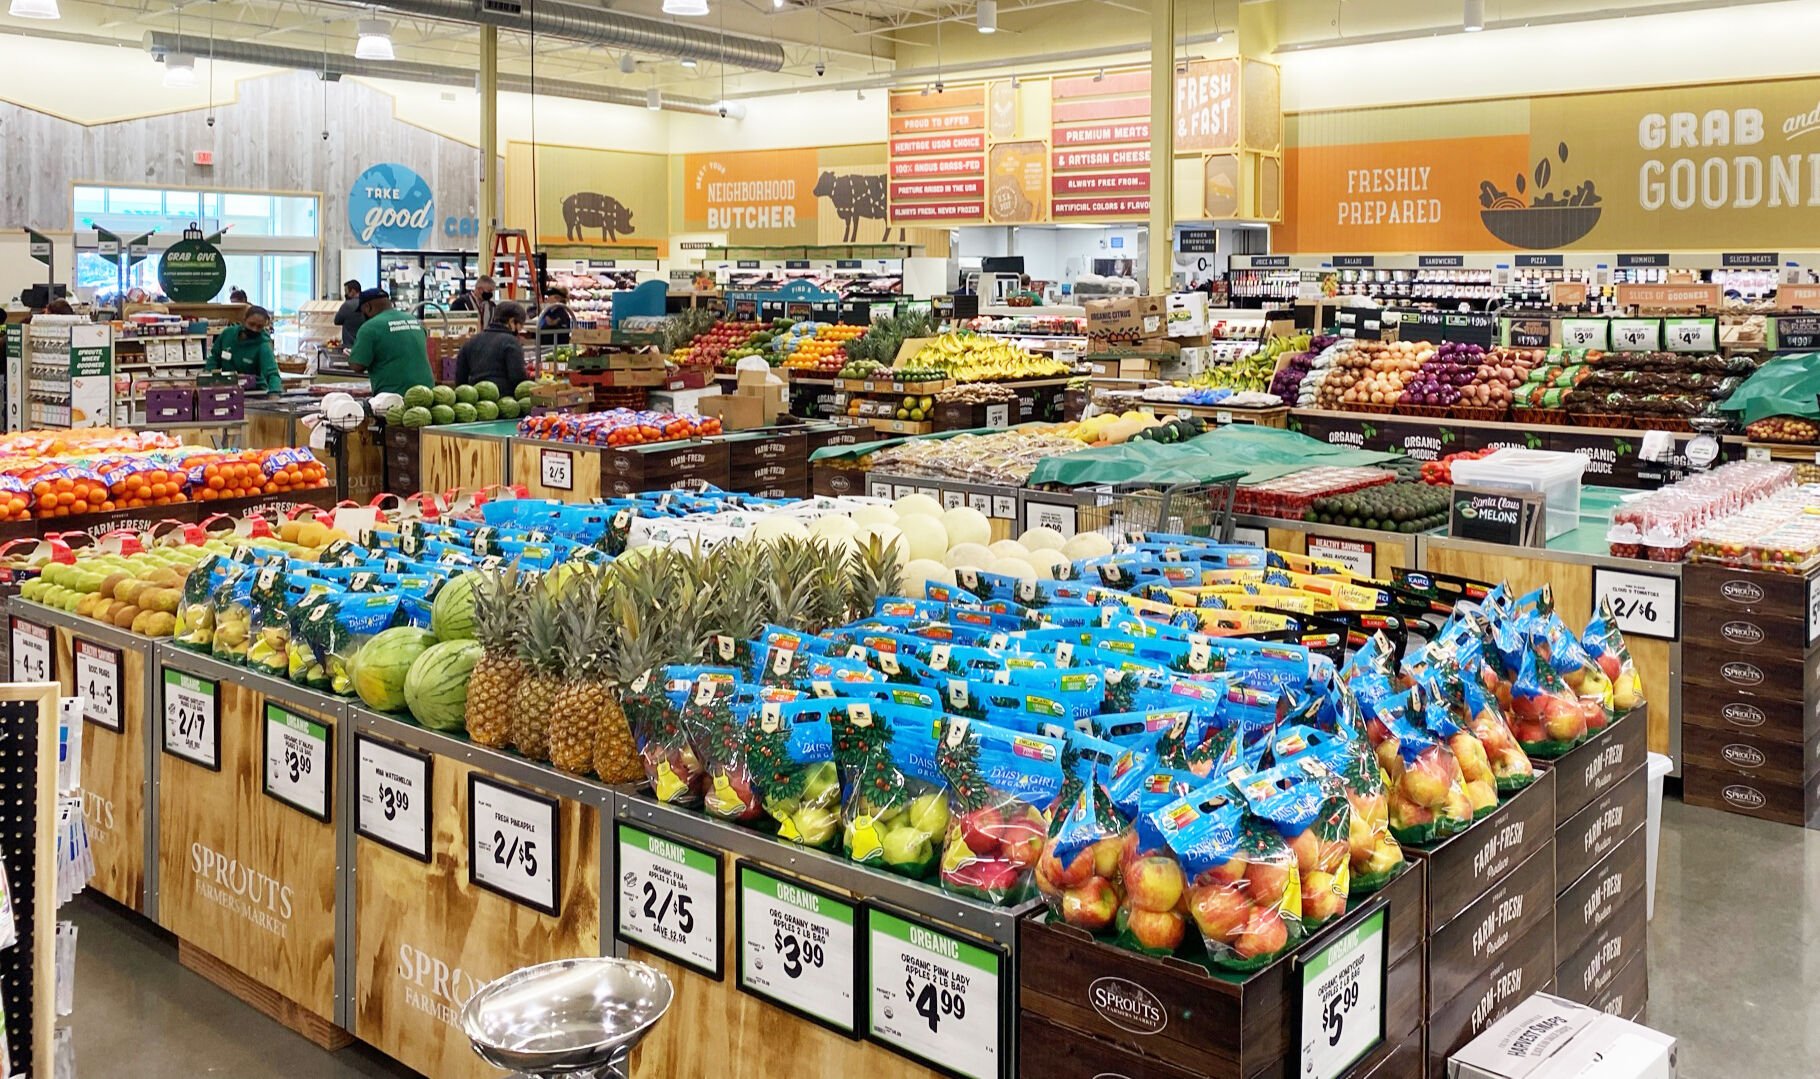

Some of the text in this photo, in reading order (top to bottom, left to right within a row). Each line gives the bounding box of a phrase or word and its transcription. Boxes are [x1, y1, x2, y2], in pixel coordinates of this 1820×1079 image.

[1176, 73, 1232, 114] FRESH
[904, 116, 969, 128] PROUD TO OFFER
[1177, 98, 1232, 136] & FAST
[1066, 126, 1148, 142] PREMIUM MEATS
[1638, 107, 1765, 151] GRAB
[895, 141, 929, 152] HERITAGE
[953, 138, 980, 148] CHOICE
[896, 160, 980, 173] 100% ANGUS GRASS-FED
[1058, 155, 1065, 166] &
[1068, 152, 1110, 165] ARTISAN
[965, 184, 977, 192] USA
[1068, 177, 1146, 188] ALWAYS FREE FROM...
[1347, 166, 1433, 194] FRESHLY
[365, 188, 400, 199] TAKE
[708, 180, 795, 202] NEIGHBORHOOD
[708, 205, 796, 229] BUTCHER
[895, 208, 916, 216] ALWAYS
[938, 206, 956, 214] NEVER
[957, 205, 979, 213] FROZEN
[1055, 203, 1090, 212] ARTIFICIAL
[1092, 202, 1118, 210] COLORS
[1337, 199, 1441, 225] PREPARED
[362, 200, 432, 241] good
[167, 252, 217, 262] GRAB GIVE
[1729, 255, 1750, 263] SLICED
[1629, 291, 1654, 300] SLICES
[1091, 310, 1131, 320] ORGANIC CITRUS
[1328, 431, 1364, 445] ORGANIC
[1404, 436, 1442, 451] ORGANIC
[754, 443, 785, 455] FARM-FRESH
[1407, 448, 1438, 461] PRODUCE
[670, 453, 705, 467] FARM-FRESH
[754, 467, 785, 479] FARM-FRESH
[1471, 496, 1520, 510] Santa Claus
[1478, 508, 1518, 525] MELONS
[87, 519, 151, 537] FARM-FRESH
[1315, 539, 1365, 552] HEALTHY SAVINGS
[1724, 586, 1760, 597] SPROUTS
[1614, 597, 1657, 622] 2/$6
[1724, 627, 1761, 638] SPROUTS
[1724, 667, 1760, 679] SPROUTS
[1725, 709, 1761, 721] SPROUTS
[909, 752, 938, 771] DAISY
[1585, 744, 1624, 787] FARM-FRESH
[1725, 750, 1761, 762] SPROUTS
[385, 771, 412, 787] WATERMELON
[990, 768, 1058, 789] DAISY GIRL
[1726, 790, 1761, 803] SPROUTS
[1584, 806, 1623, 853] FARM-FRESH
[494, 830, 537, 877] 2/$5
[648, 836, 685, 864] ORGANIC
[1473, 821, 1524, 878] FARM-FRESH
[648, 871, 665, 883] APPLES
[652, 863, 683, 881] ORGANIC FUJI
[1486, 856, 1509, 881] Produce
[191, 842, 292, 919] SPROUTS
[195, 878, 288, 938] FARMERS MARKET
[643, 880, 694, 934] 2/$5
[776, 882, 819, 913] ORGANIC
[1583, 873, 1622, 925] FARM-FRESH
[653, 923, 668, 937] SAVE
[769, 908, 830, 937] ORG GRANNY SMITH
[773, 918, 795, 934] APPLES
[802, 929, 811, 939] LB
[813, 933, 826, 945] BAG
[1472, 894, 1523, 957] FARM-FRESH
[909, 926, 959, 959] ORGANIC
[1327, 928, 1360, 966] ORGANIC
[1486, 931, 1509, 958] Produce
[901, 953, 970, 987] ORGANIC PINK LADY
[1583, 936, 1622, 991] FARM-FRESH
[905, 965, 930, 981] APPLES
[939, 977, 949, 988] LB
[950, 980, 966, 994] BAG
[1317, 954, 1365, 997] ORGANIC HONEYCRISP
[1322, 987, 1339, 1003] APPLES
[1351, 969, 1361, 983] BAG
[1095, 988, 1160, 1021] SPROUTS
[1471, 967, 1522, 1035] FARM-FRESH
[1106, 1006, 1157, 1027] FARMERS MARKET
[1507, 1030, 1540, 1057] HARVEST
[1533, 1015, 1568, 1035] SNAPS
